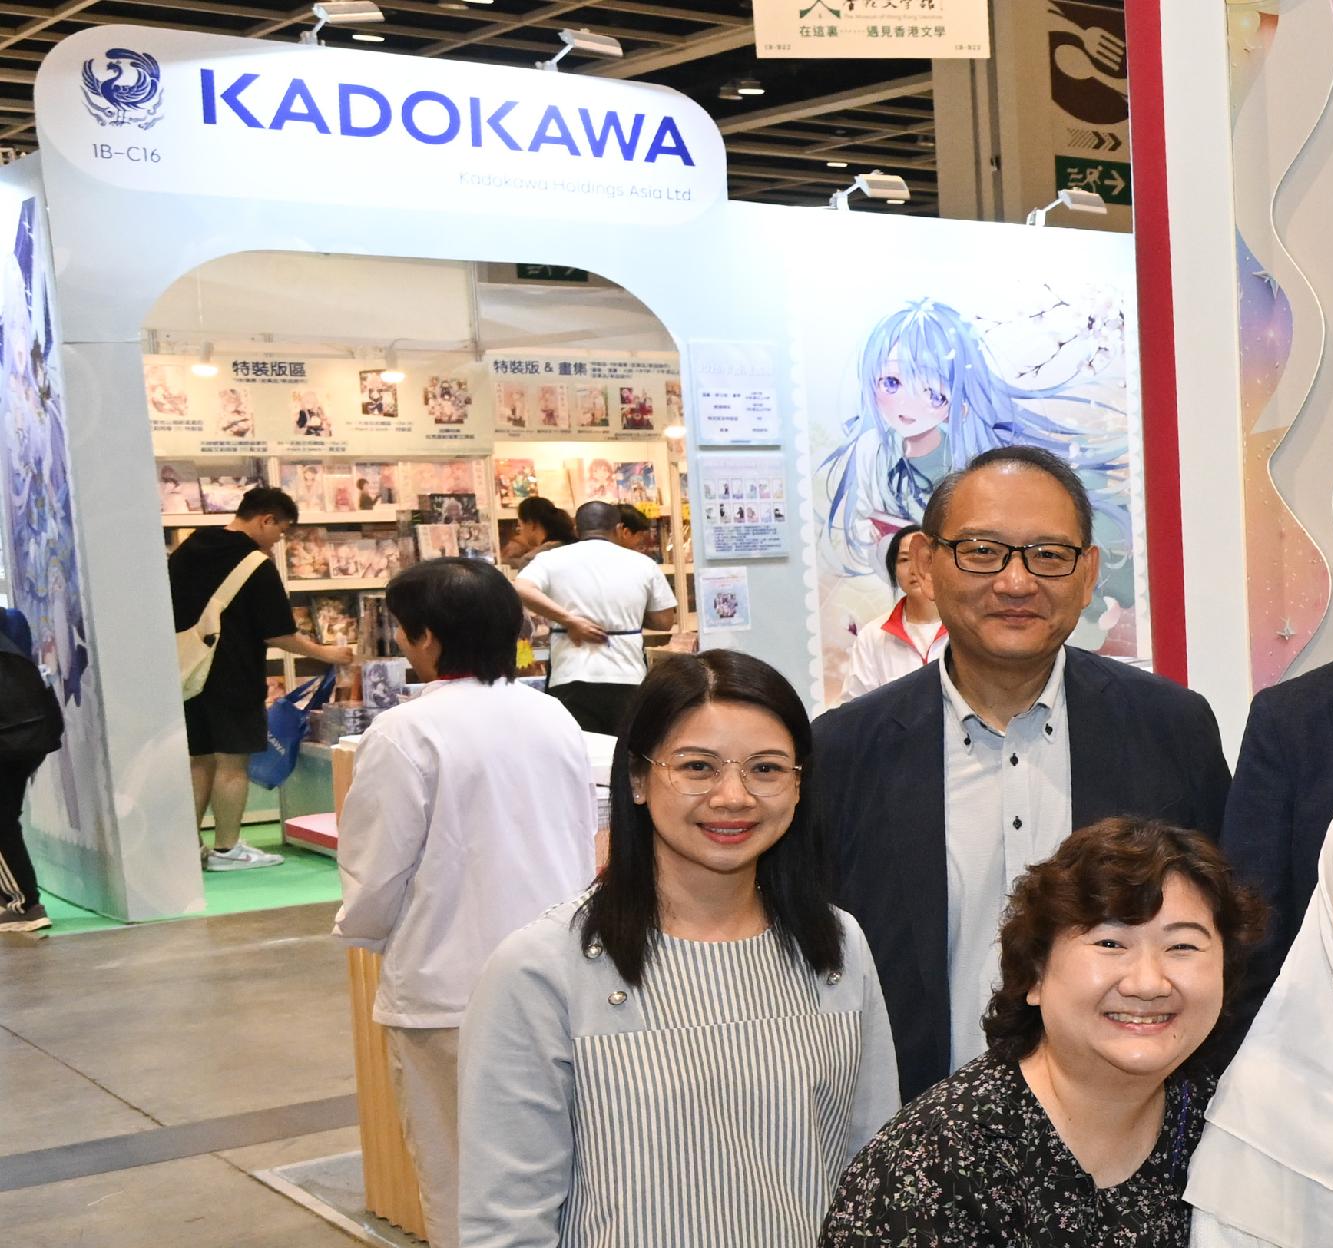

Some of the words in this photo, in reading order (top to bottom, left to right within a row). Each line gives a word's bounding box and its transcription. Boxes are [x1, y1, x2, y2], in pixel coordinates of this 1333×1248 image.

[200, 67, 696, 167] KADOKAWA
[459, 171, 548, 190] Kadokawa
[553, 178, 625, 198] Holdings
[630, 184, 662, 199] Asia
[232, 360, 307, 376] 特裝版區
